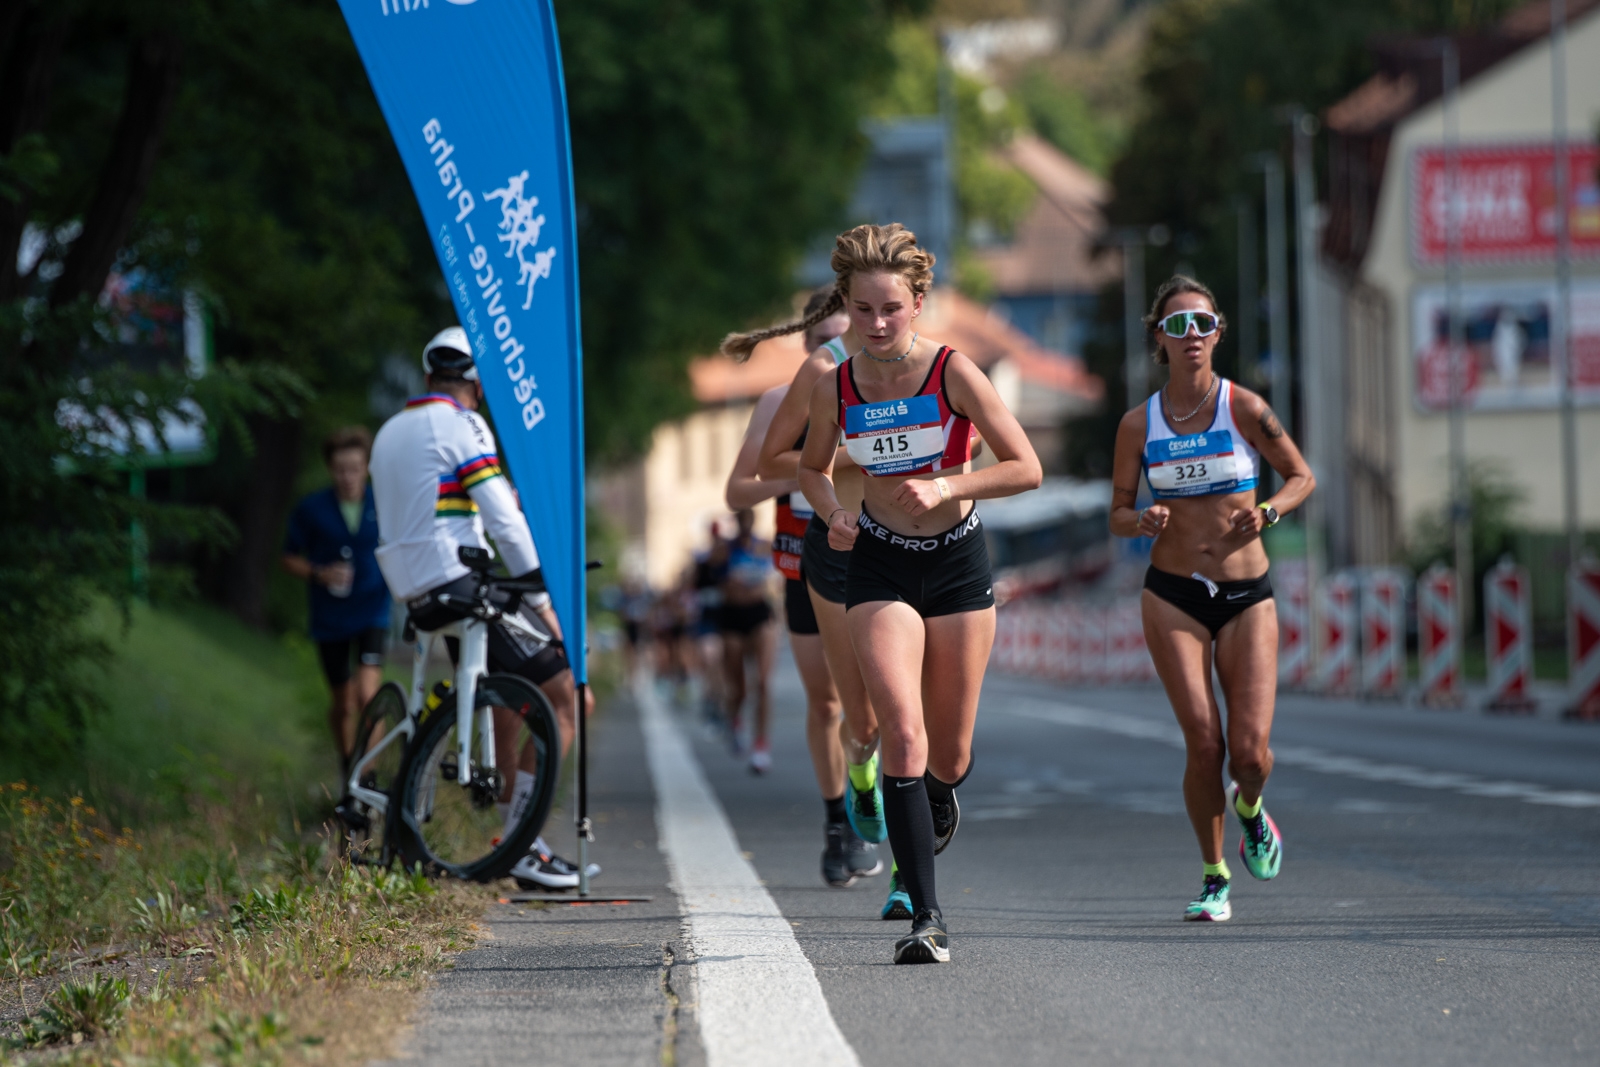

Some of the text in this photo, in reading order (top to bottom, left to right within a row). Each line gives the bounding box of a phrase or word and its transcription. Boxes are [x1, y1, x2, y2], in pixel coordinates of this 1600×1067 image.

[864, 404, 897, 420] ČESKÁ
[865, 417, 895, 428] spořitelna
[872, 434, 909, 455] 415
[1168, 437, 1196, 452] ČESKÁ
[888, 451, 913, 460] HAVLOVÁ
[1175, 463, 1207, 481] 323
[859, 508, 980, 552] NIKE PRO NIKE
